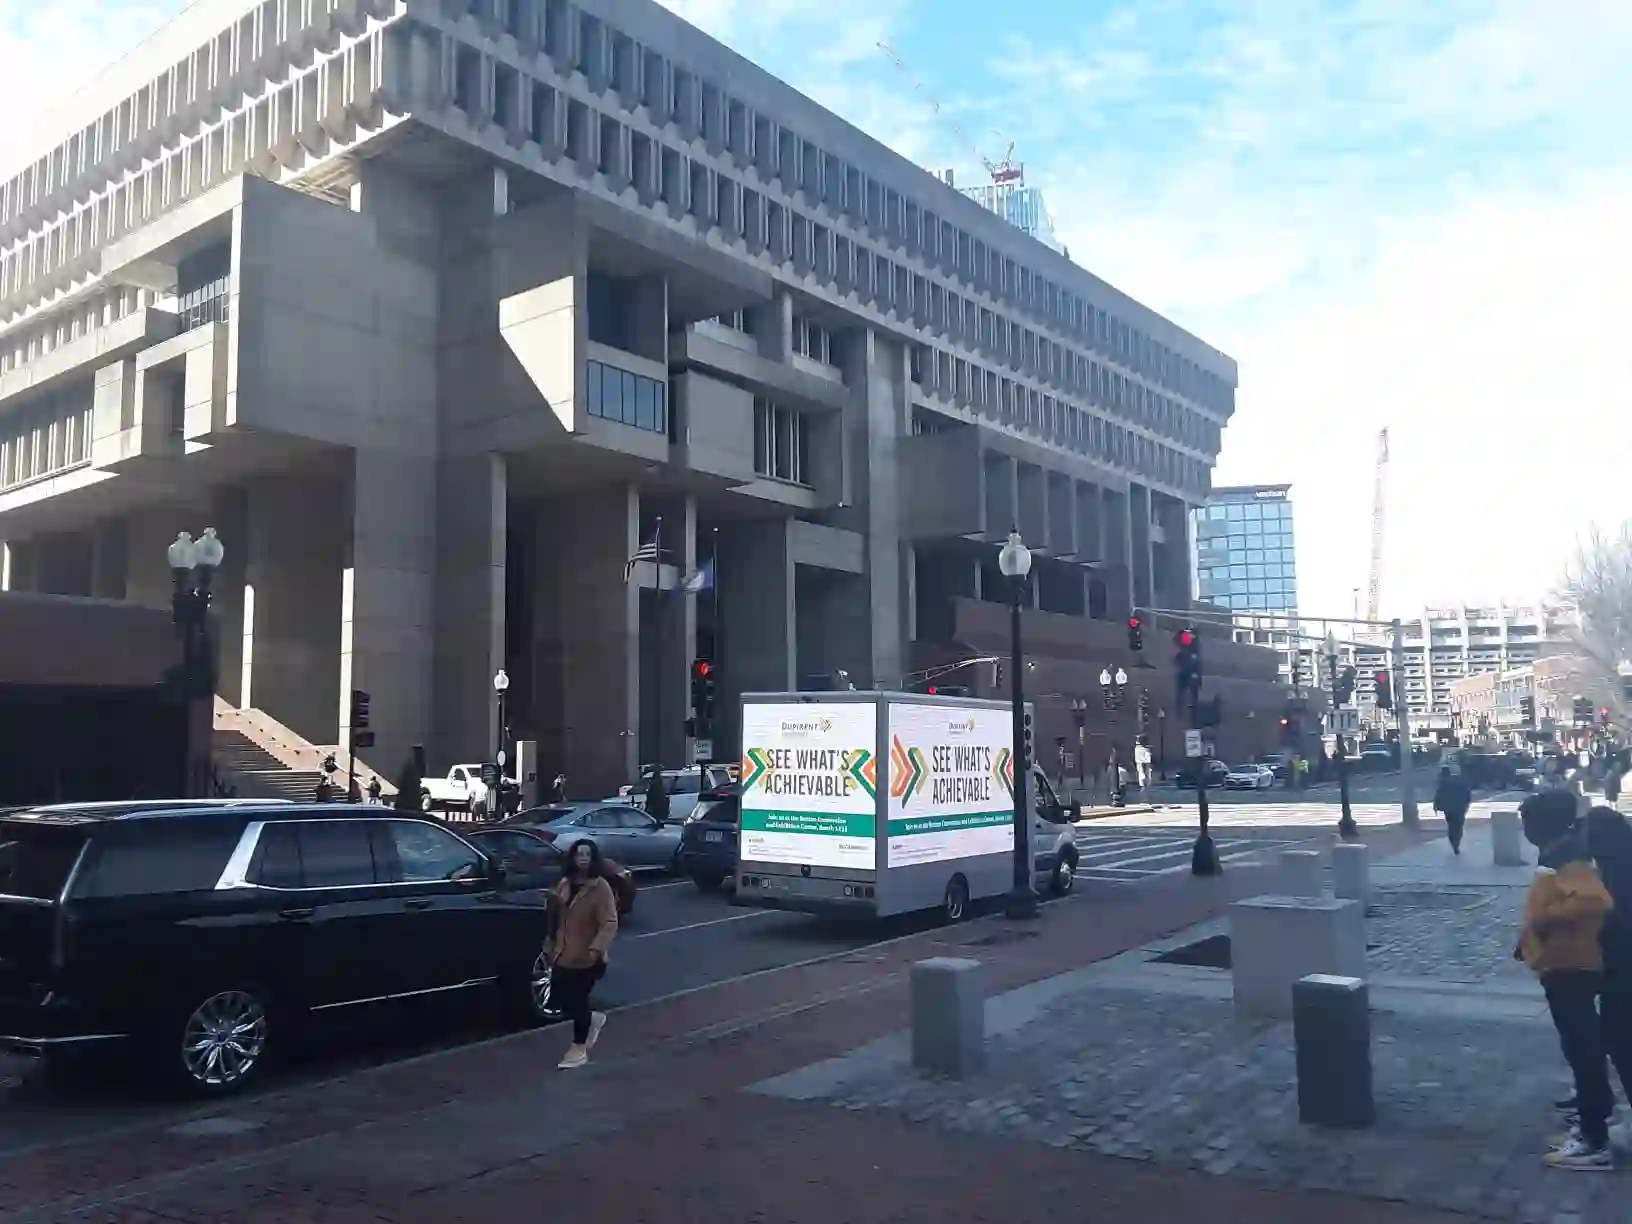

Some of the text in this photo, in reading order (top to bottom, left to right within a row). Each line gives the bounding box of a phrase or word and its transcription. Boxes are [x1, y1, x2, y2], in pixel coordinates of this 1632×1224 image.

[766, 748, 851, 771] SEE WHAT'S
[932, 745, 991, 773] SEE WHAT'S
[764, 774, 851, 797] ACHIEVABLE
[932, 776, 991, 805] ACHIEVABLE
